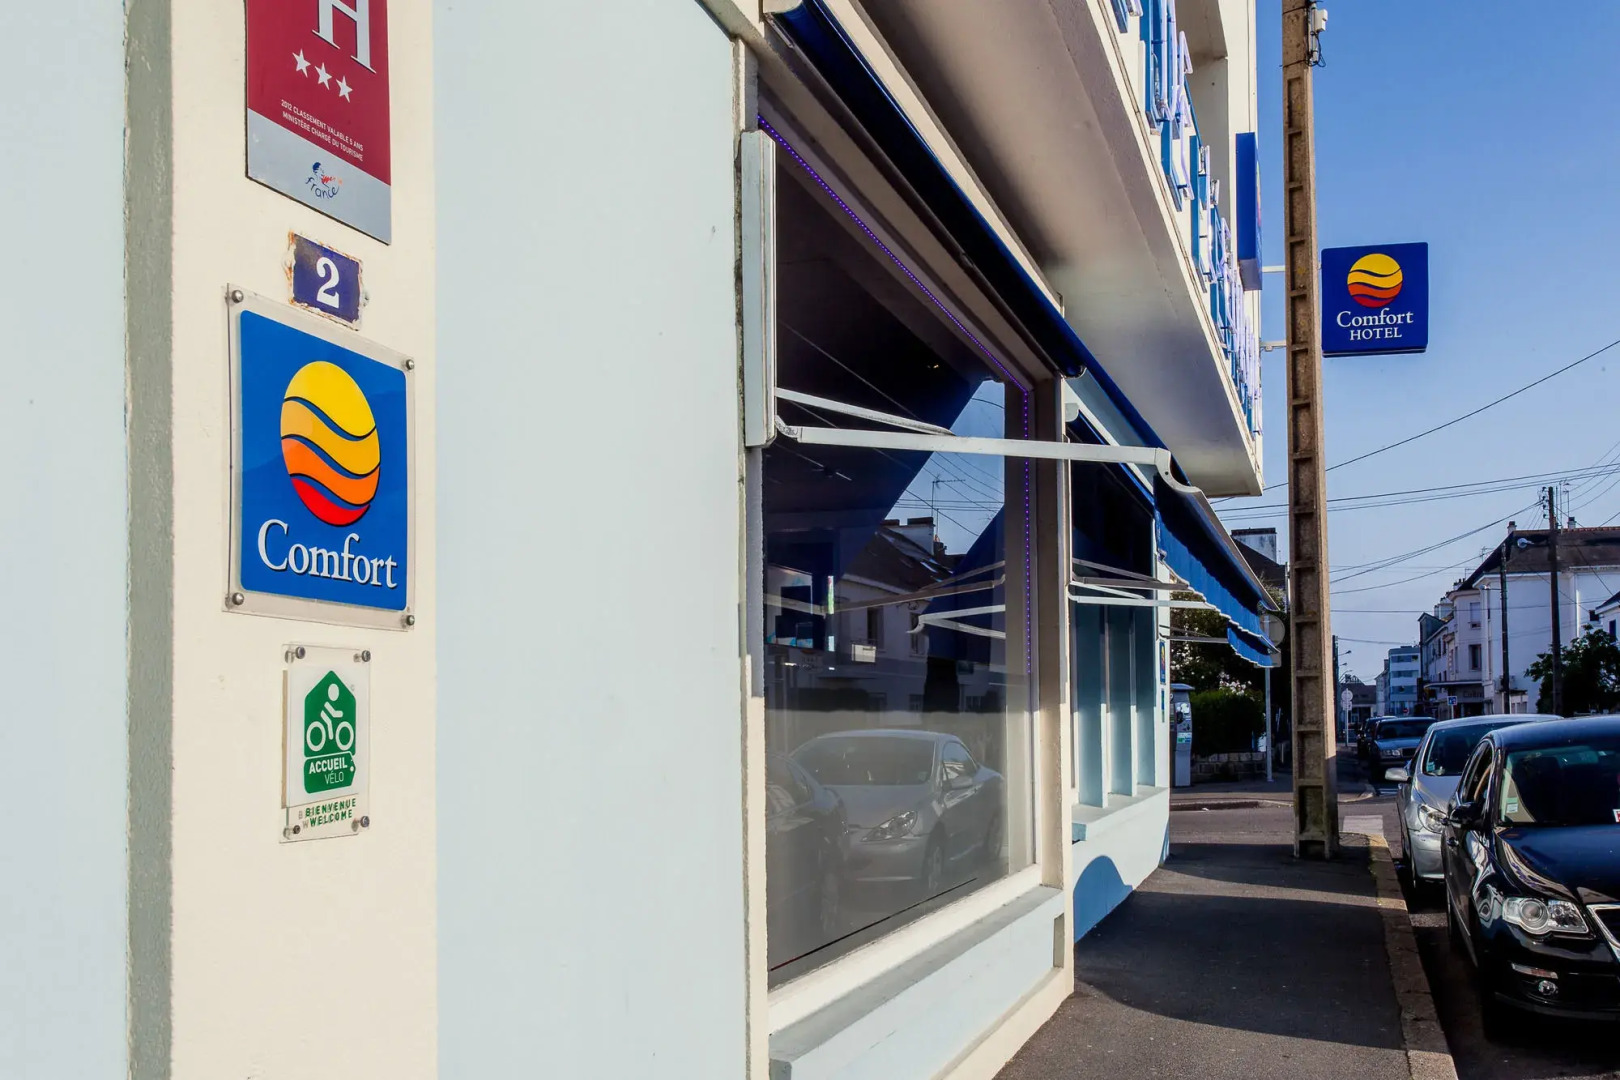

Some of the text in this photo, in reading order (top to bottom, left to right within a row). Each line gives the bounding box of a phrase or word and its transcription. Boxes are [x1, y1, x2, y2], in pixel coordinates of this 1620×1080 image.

[311, 0, 377, 74] H
[281, 99, 293, 111] 2012
[293, 106, 327, 130] CLASSEMENT
[327, 124, 349, 144] VALABLE
[353, 141, 364, 152] ANS
[282, 110, 311, 132] MINISTÈRE
[331, 138, 340, 147] DU
[340, 142, 364, 162] TOURISME
[316, 256, 340, 309] 2
[1336, 307, 1414, 328] Comfort
[1349, 327, 1402, 341] HOTEL
[257, 518, 398, 589] Comfort
[309, 757, 348, 774] ACCUEIL
[324, 770, 345, 784] VÉLO
[305, 798, 356, 817] BIENVENUE
[309, 809, 353, 827] WELCOME
